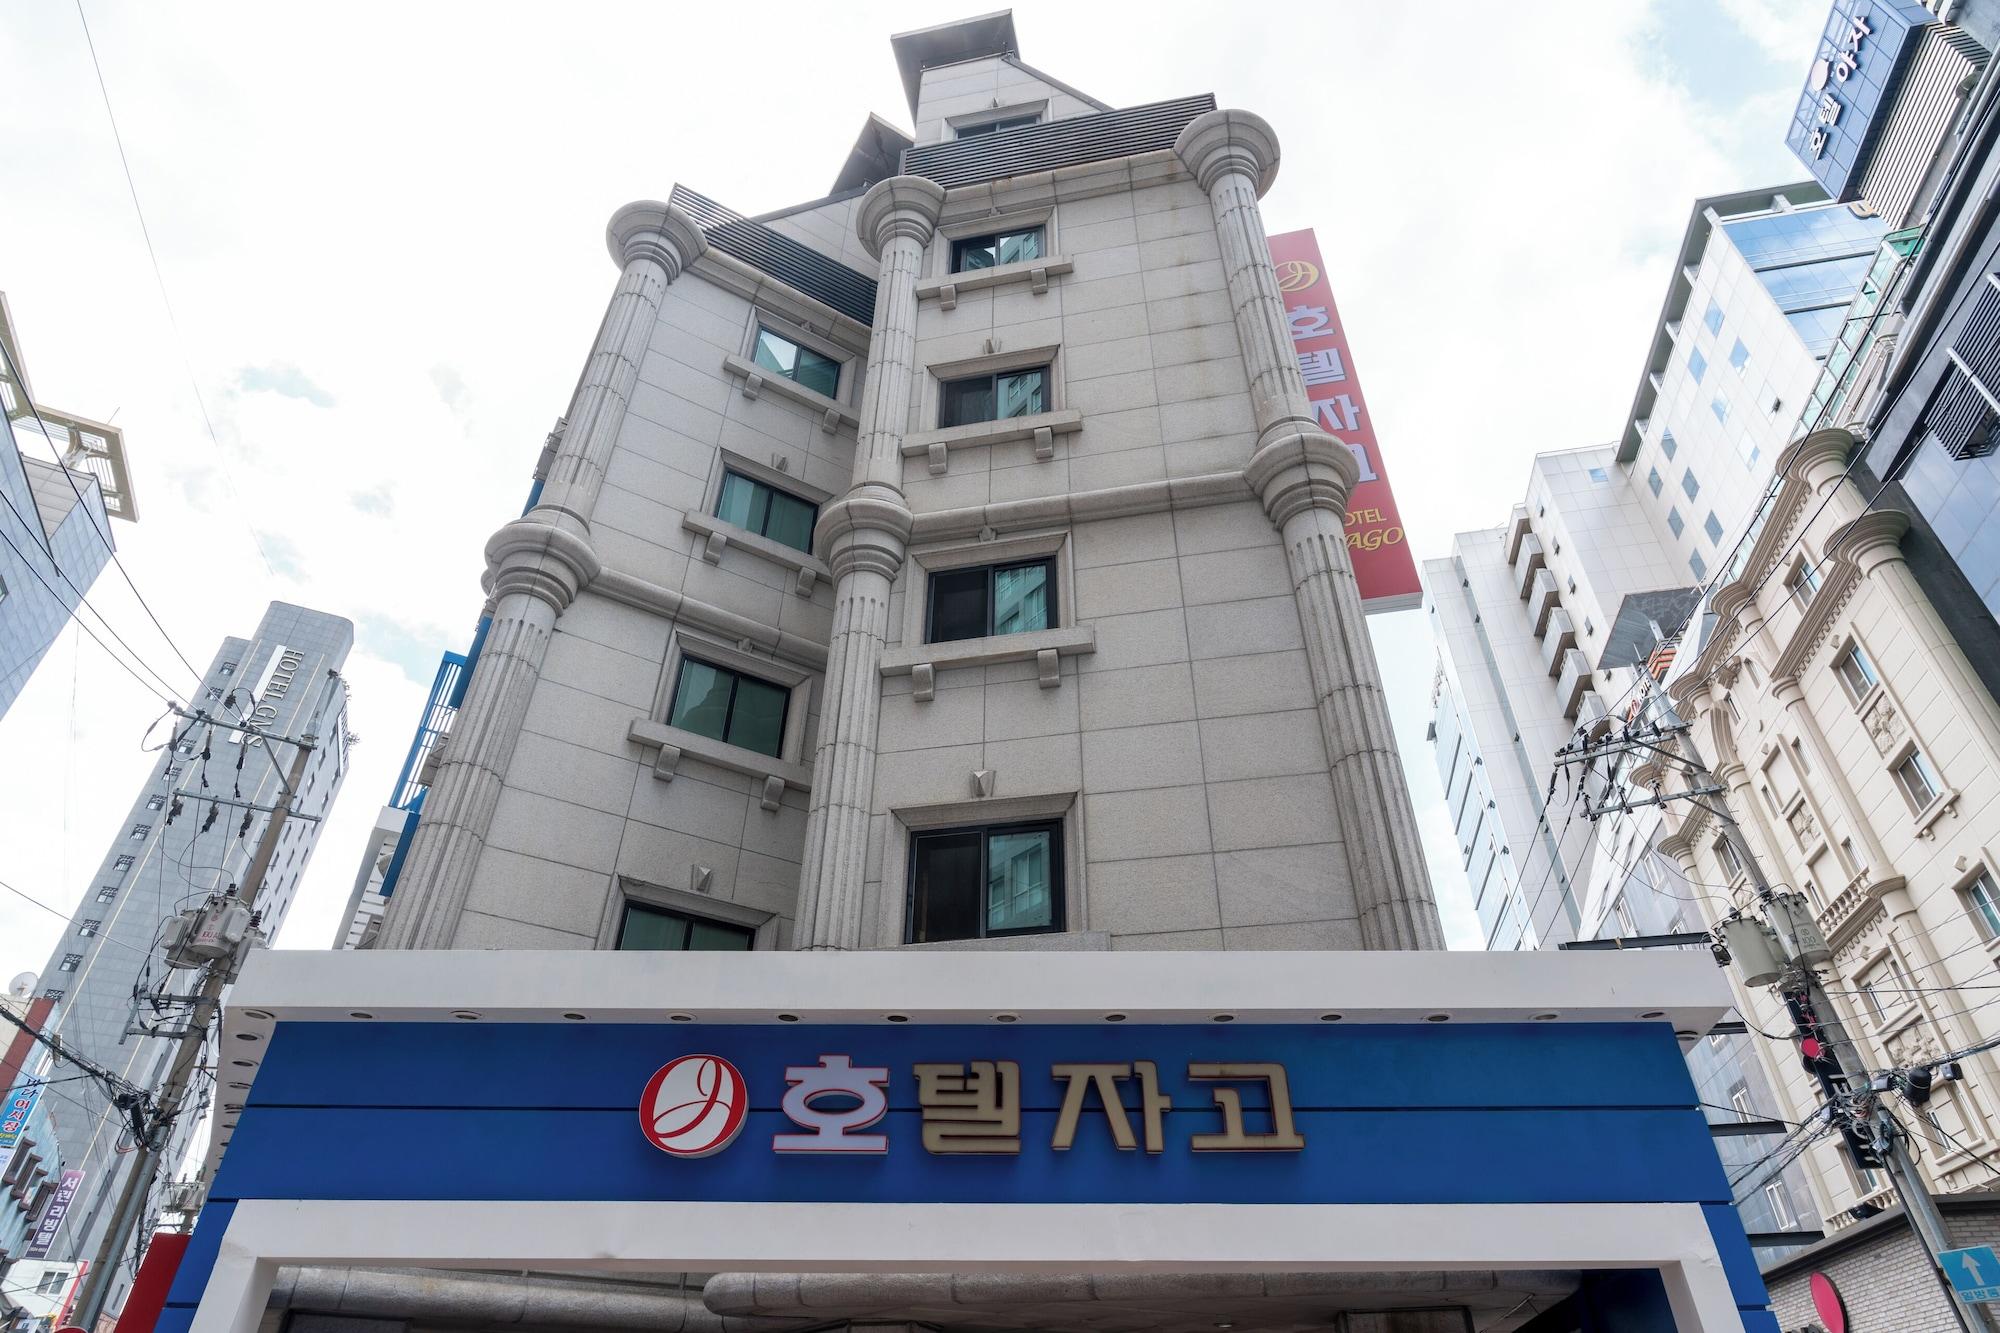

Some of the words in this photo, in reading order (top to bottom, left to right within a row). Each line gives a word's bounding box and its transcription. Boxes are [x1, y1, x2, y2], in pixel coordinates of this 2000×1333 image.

[1344, 508, 1387, 527] OTEL
[1345, 527, 1404, 551] AGO
[262, 648, 305, 702] HOTEL
[772, 1054, 1305, 1155] 호텔자고
